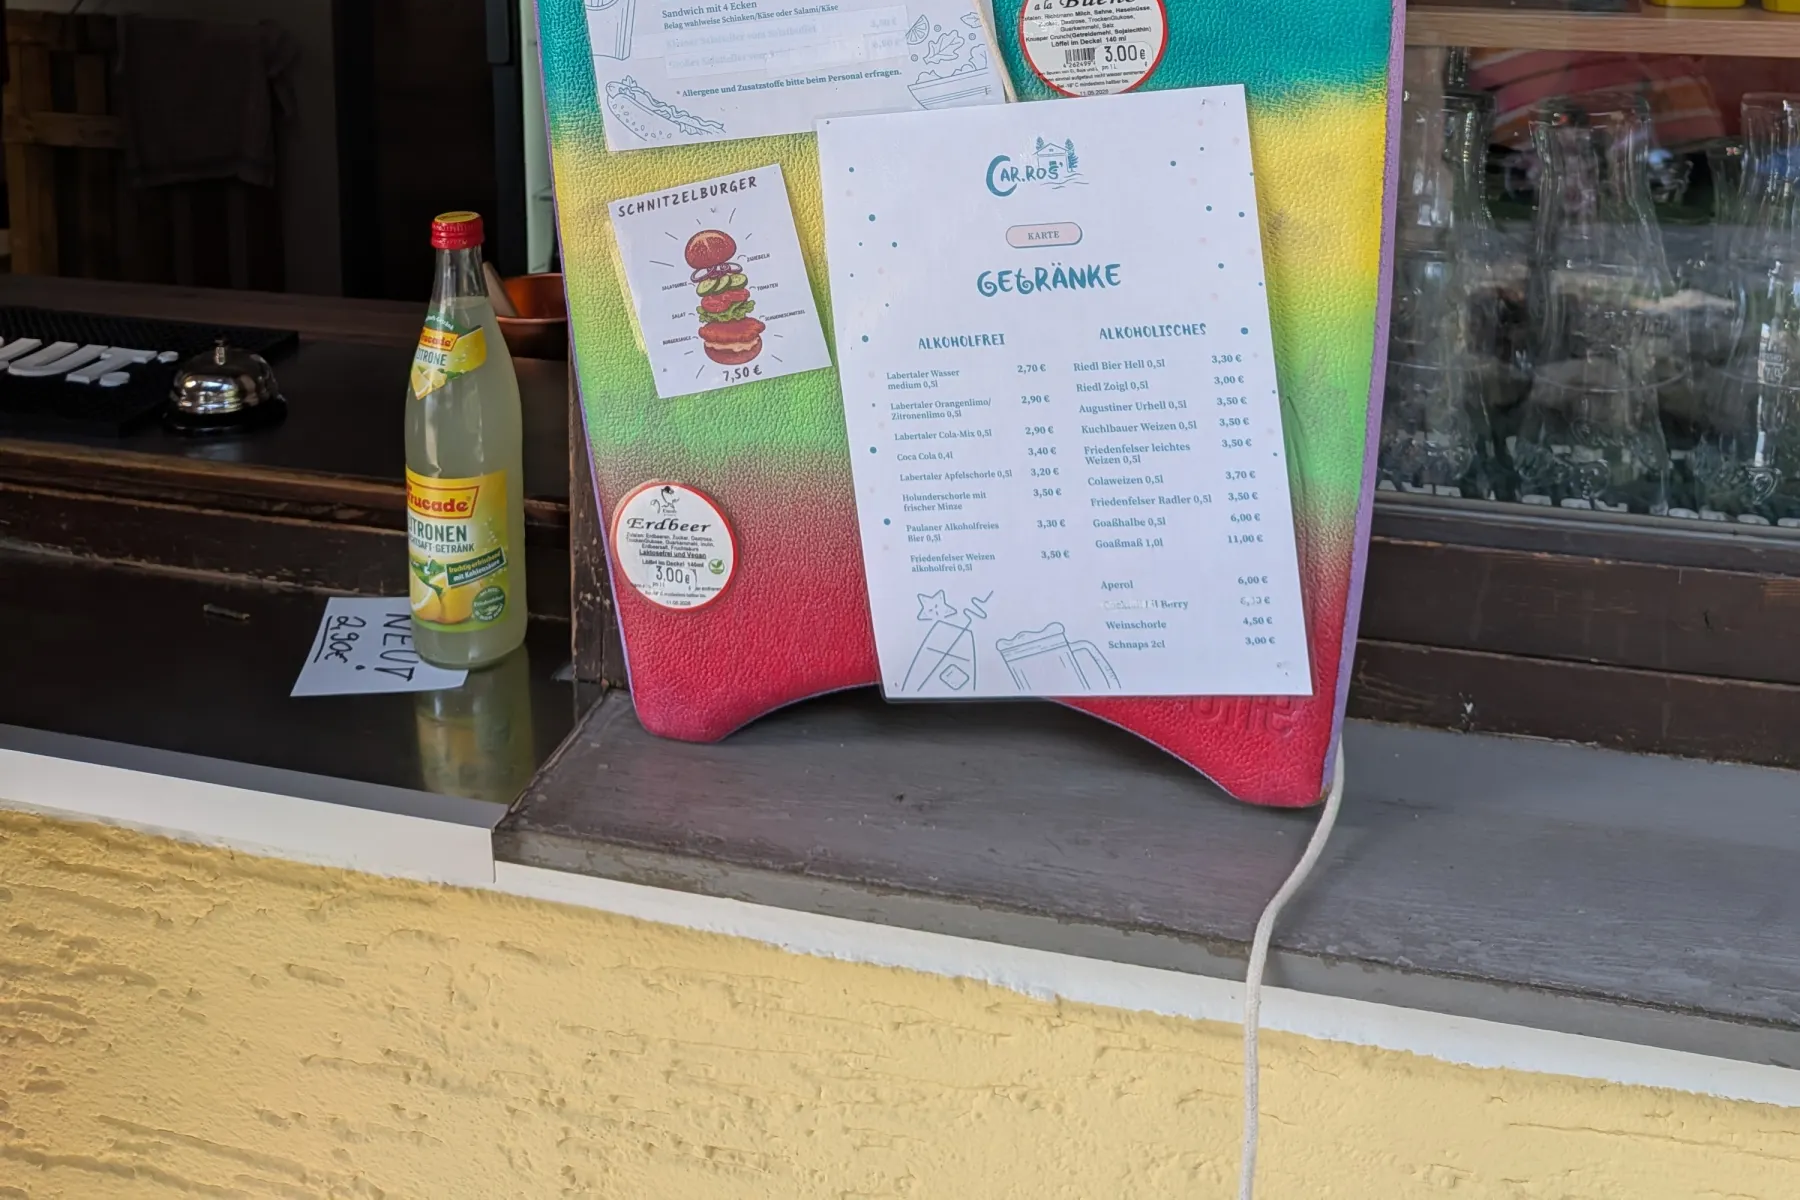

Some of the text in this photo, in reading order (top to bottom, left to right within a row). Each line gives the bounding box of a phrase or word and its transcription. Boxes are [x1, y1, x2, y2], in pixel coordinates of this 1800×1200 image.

[1034, 3, 1041, 11] a
[1043, 0, 1053, 10] la
[682, 69, 903, 98] Allergene und Zusatzstoffe bitte beim Personal erfragen.
[618, 176, 757, 217] SCHNITZELBURGER
[1027, 230, 1060, 241] KARTE
[1099, 322, 1207, 340] ALKOHOLISCHES
[918, 333, 1005, 350] ALKOHOLFREI
[1016, 363, 1047, 374] 2,70 €
[1073, 361, 1100, 372] Riedl
[1101, 360, 1122, 371] Bier
[1123, 359, 1145, 370] Hell
[723, 364, 763, 383] 7,50 €
[886, 369, 960, 380] Labertaler Wasser
[887, 381, 922, 391] medium
[896, 453, 918, 462] Coca
[917, 451, 937, 461] Cola
[1090, 496, 1156, 507] Friedenfelser
[1157, 494, 1192, 505] Radler
[408, 513, 467, 543] ITRONEN
[626, 518, 712, 533] Erdbeer
[1094, 537, 1144, 549] Goaßmaß
[1227, 534, 1264, 545] 11,00 €
[1100, 579, 1134, 592] Aperol
[1105, 619, 1167, 630] Weinschorle
[1108, 639, 1166, 651] Schnaps 2cl
